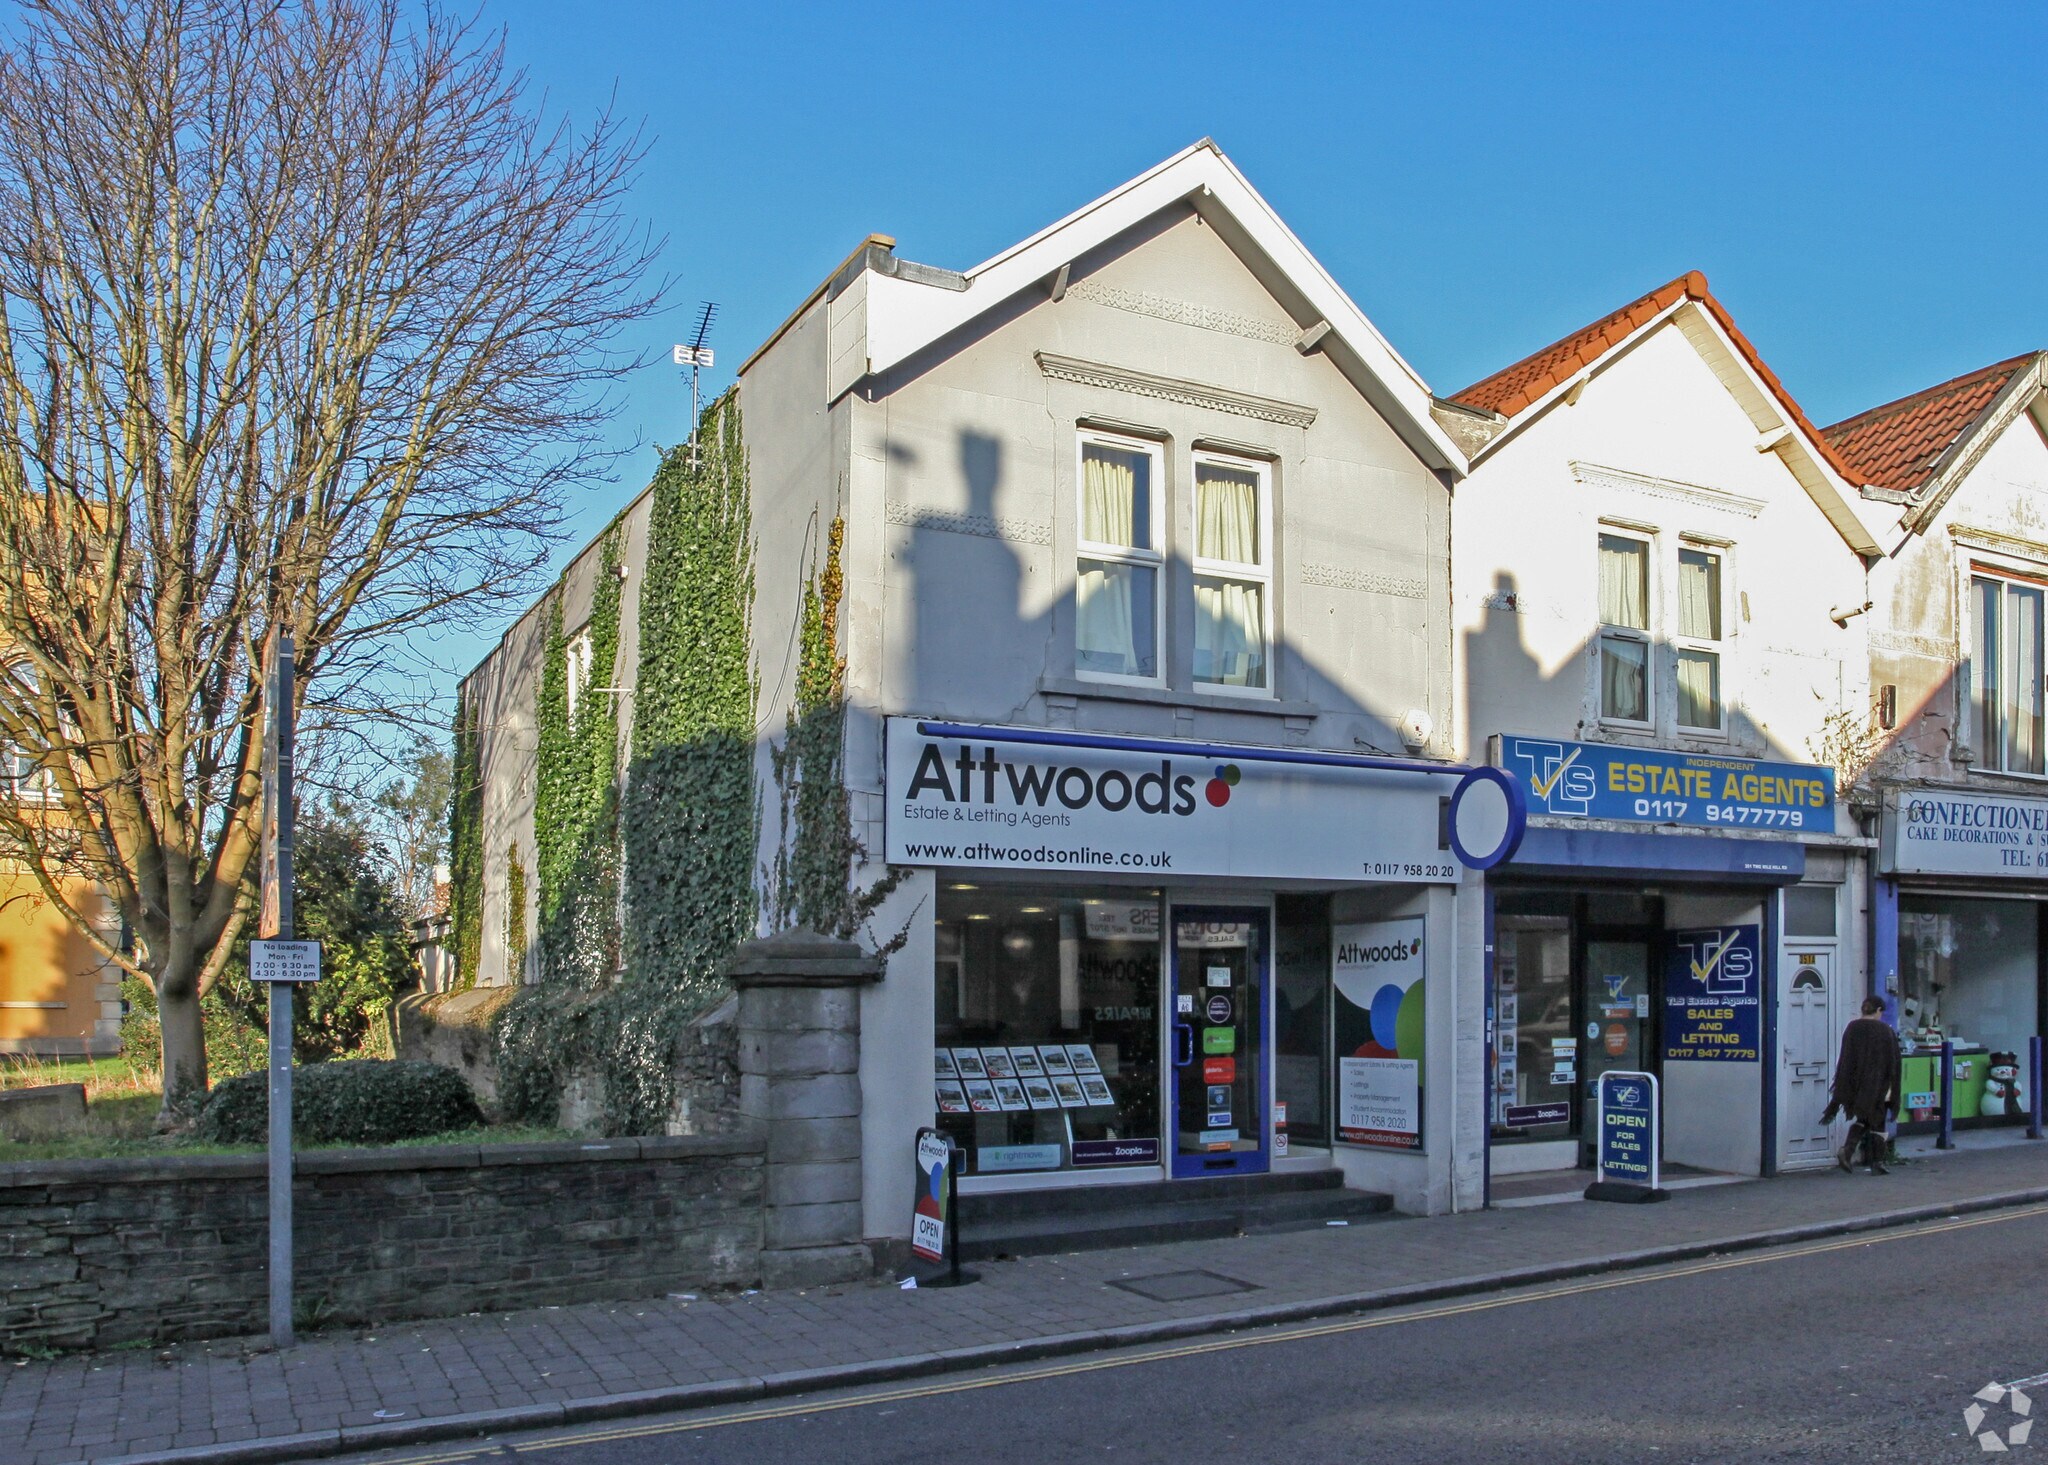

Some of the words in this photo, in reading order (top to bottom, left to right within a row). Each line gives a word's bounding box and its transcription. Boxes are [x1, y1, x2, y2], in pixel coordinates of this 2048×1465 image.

[1686, 758, 1755, 772] INDEPENDENT
[906, 743, 1196, 816] Attwoods
[1608, 762, 1712, 799] ESTATE
[1722, 773, 1825, 808] AGENTS
[904, 804, 949, 820] Estate
[953, 807, 964, 821] &
[967, 808, 1017, 826] Letting
[1021, 811, 1070, 828] Agents
[1634, 798, 1688, 818] 0117
[1706, 805, 1803, 827] 9477779
[1908, 799, 2048, 831] CONFECTIONE
[1907, 825, 1938, 840] CAKE
[1944, 828, 2020, 845] DECORATIONS
[2026, 833, 2033, 846] &
[905, 843, 1172, 867] www.attwoodsonline.co.uk
[2000, 849, 2031, 866] TEL:
[1363, 863, 1371, 874] T:
[1374, 863, 1399, 875] 0117
[1403, 864, 1422, 876] 958
[1425, 865, 1438, 876] 20
[1441, 865, 1454, 877] 20
[1337, 940, 1408, 964] Attwoods
[1686, 996, 1719, 1006] Estate
[1721, 996, 1758, 1007] Agents
[1687, 1009, 1734, 1019] SALES
[1698, 1022, 1722, 1030] AND
[1682, 1034, 1740, 1044] LETTING
[1668, 1048, 1693, 1057] 0117
[1698, 1048, 1720, 1057] 947
[1724, 1049, 1755, 1058] 7779
[1370, 1095, 1400, 1103] Management
[1351, 1114, 1369, 1125] 0117
[1371, 1116, 1385, 1127] 958
[1388, 1117, 1406, 1129] 2020
[1606, 1114, 1646, 1128] OPEN
[1339, 1131, 1419, 1145] www.attwoodsonline.co.uk
[1616, 1131, 1635, 1140] FOR
[920, 1142, 943, 1157] Attwoods
[1611, 1141, 1640, 1151] SALES
[1604, 1161, 1647, 1172] LETTINGS
[920, 1219, 939, 1238] OPEN
